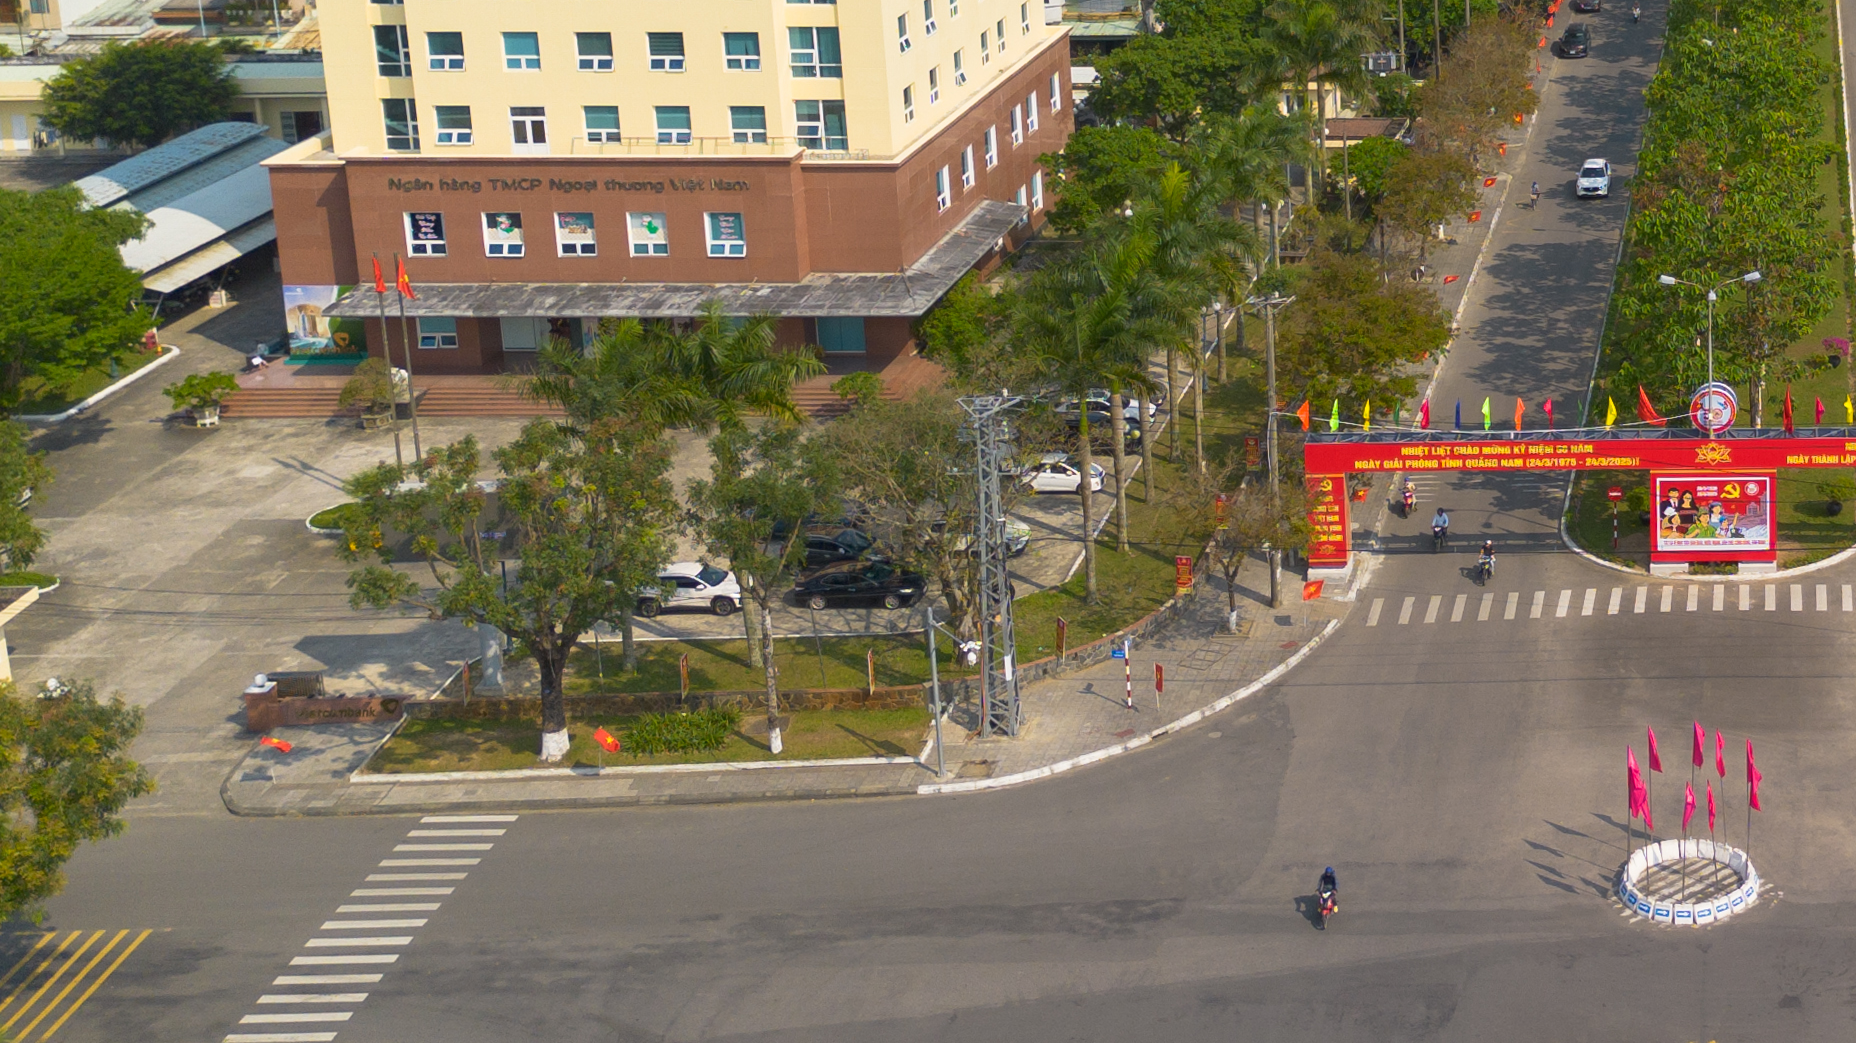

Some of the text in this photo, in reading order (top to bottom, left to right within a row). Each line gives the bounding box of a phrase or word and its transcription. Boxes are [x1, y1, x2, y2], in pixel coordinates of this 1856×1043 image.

[388, 178, 433, 192] Ngân
[488, 178, 542, 191] TMCP
[711, 178, 750, 191] Nam
[1431, 445, 1451, 457] LIỆT
[1354, 458, 1380, 469] NGÀY
[1466, 457, 1498, 468] QUẢNG
[1500, 458, 1524, 467] NAM
[1786, 454, 1810, 464] NGÀY
